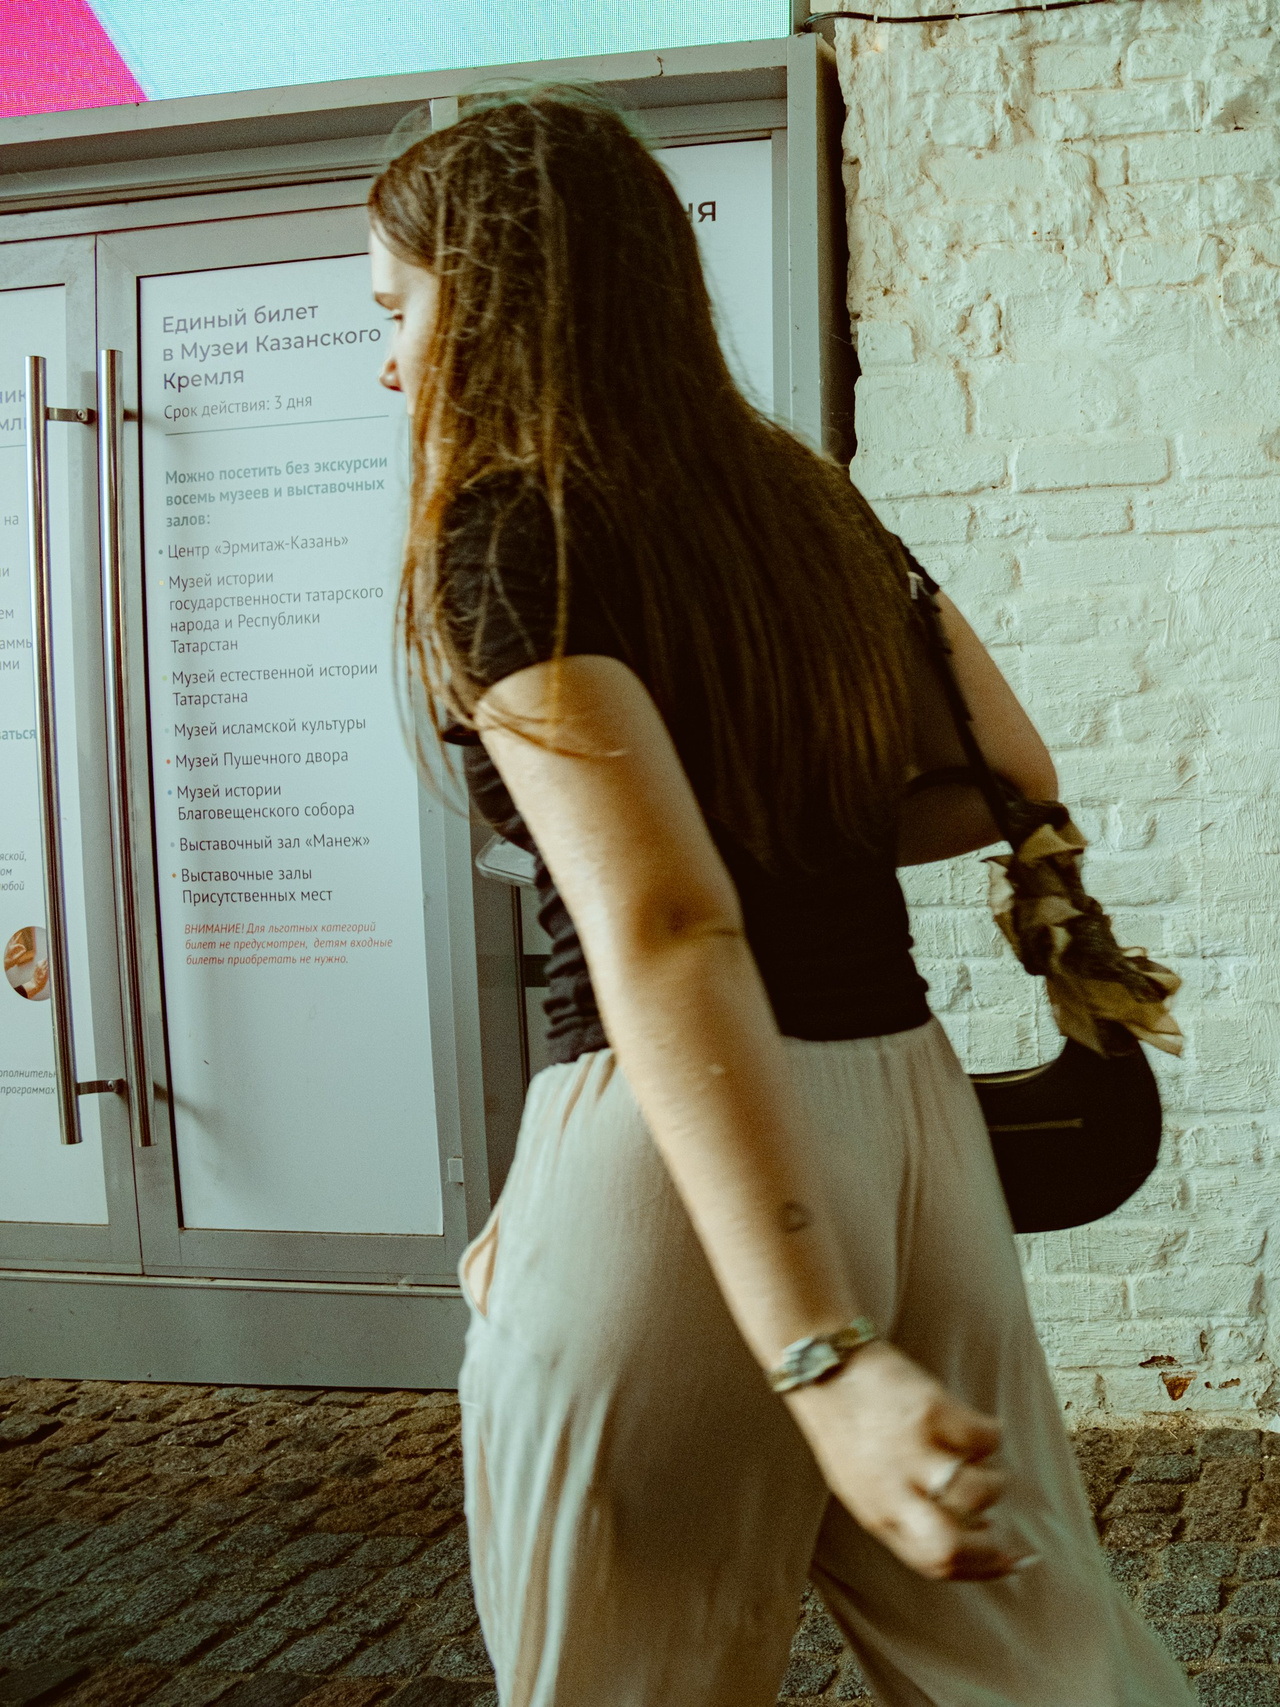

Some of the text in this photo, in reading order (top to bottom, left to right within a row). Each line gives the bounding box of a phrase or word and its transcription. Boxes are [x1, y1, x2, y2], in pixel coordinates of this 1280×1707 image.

[163, 305, 319, 335] Единый билет
[163, 328, 381, 362] в Музеи Казанского
[163, 370, 244, 393] Кремля
[164, 395, 312, 422] Срок действия: 3 дня
[166, 458, 387, 484] Можно посетить без экскурсии
[166, 480, 384, 506] восемь музеев и выставочных
[4, 515, 19, 526] на
[166, 515, 210, 527] залов:
[168, 536, 348, 560] Центр «Эрмитаж-Казань»
[169, 573, 273, 592] Музей истории
[170, 587, 383, 613] государственности татарского
[170, 611, 320, 635] народа и Республики
[170, 639, 238, 656] Татарстан
[172, 664, 377, 688] Музей естественной истории
[172, 692, 248, 708] Татарстана
[0, 729, 37, 740] аться
[174, 718, 366, 741] Музей исламской культуры
[175, 751, 348, 772] Музей Пушечного двора
[177, 784, 281, 802] Музей истории
[178, 801, 354, 821] Благовещенского собора
[179, 834, 370, 852] Выставочный зал «Манеж»
[181, 868, 312, 883] Выставочные залы
[182, 889, 333, 907] Присутственных мест
[185, 921, 376, 935] ВНИМАНИЕ! Для льготных категорий
[186, 937, 393, 951] билет не предусмотрен, детям входные
[186, 954, 348, 966] билеты приобретать не нужно.
